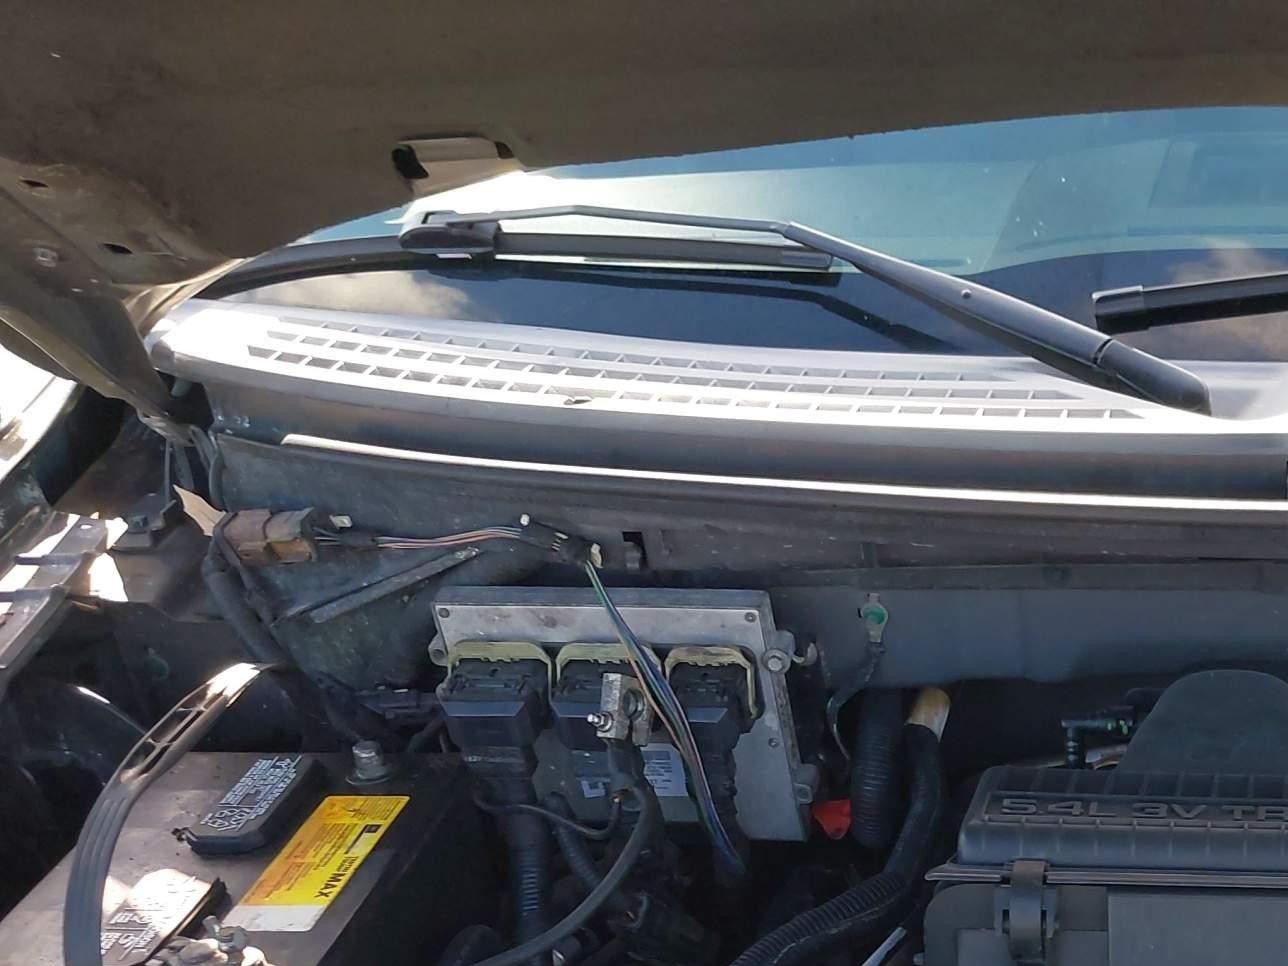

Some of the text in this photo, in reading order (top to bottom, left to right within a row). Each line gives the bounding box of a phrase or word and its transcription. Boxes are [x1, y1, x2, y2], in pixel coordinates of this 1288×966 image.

[1002, 798, 1117, 817] 5.4L
[1132, 801, 1206, 820] 3V
[314, 871, 347, 898] MAX
